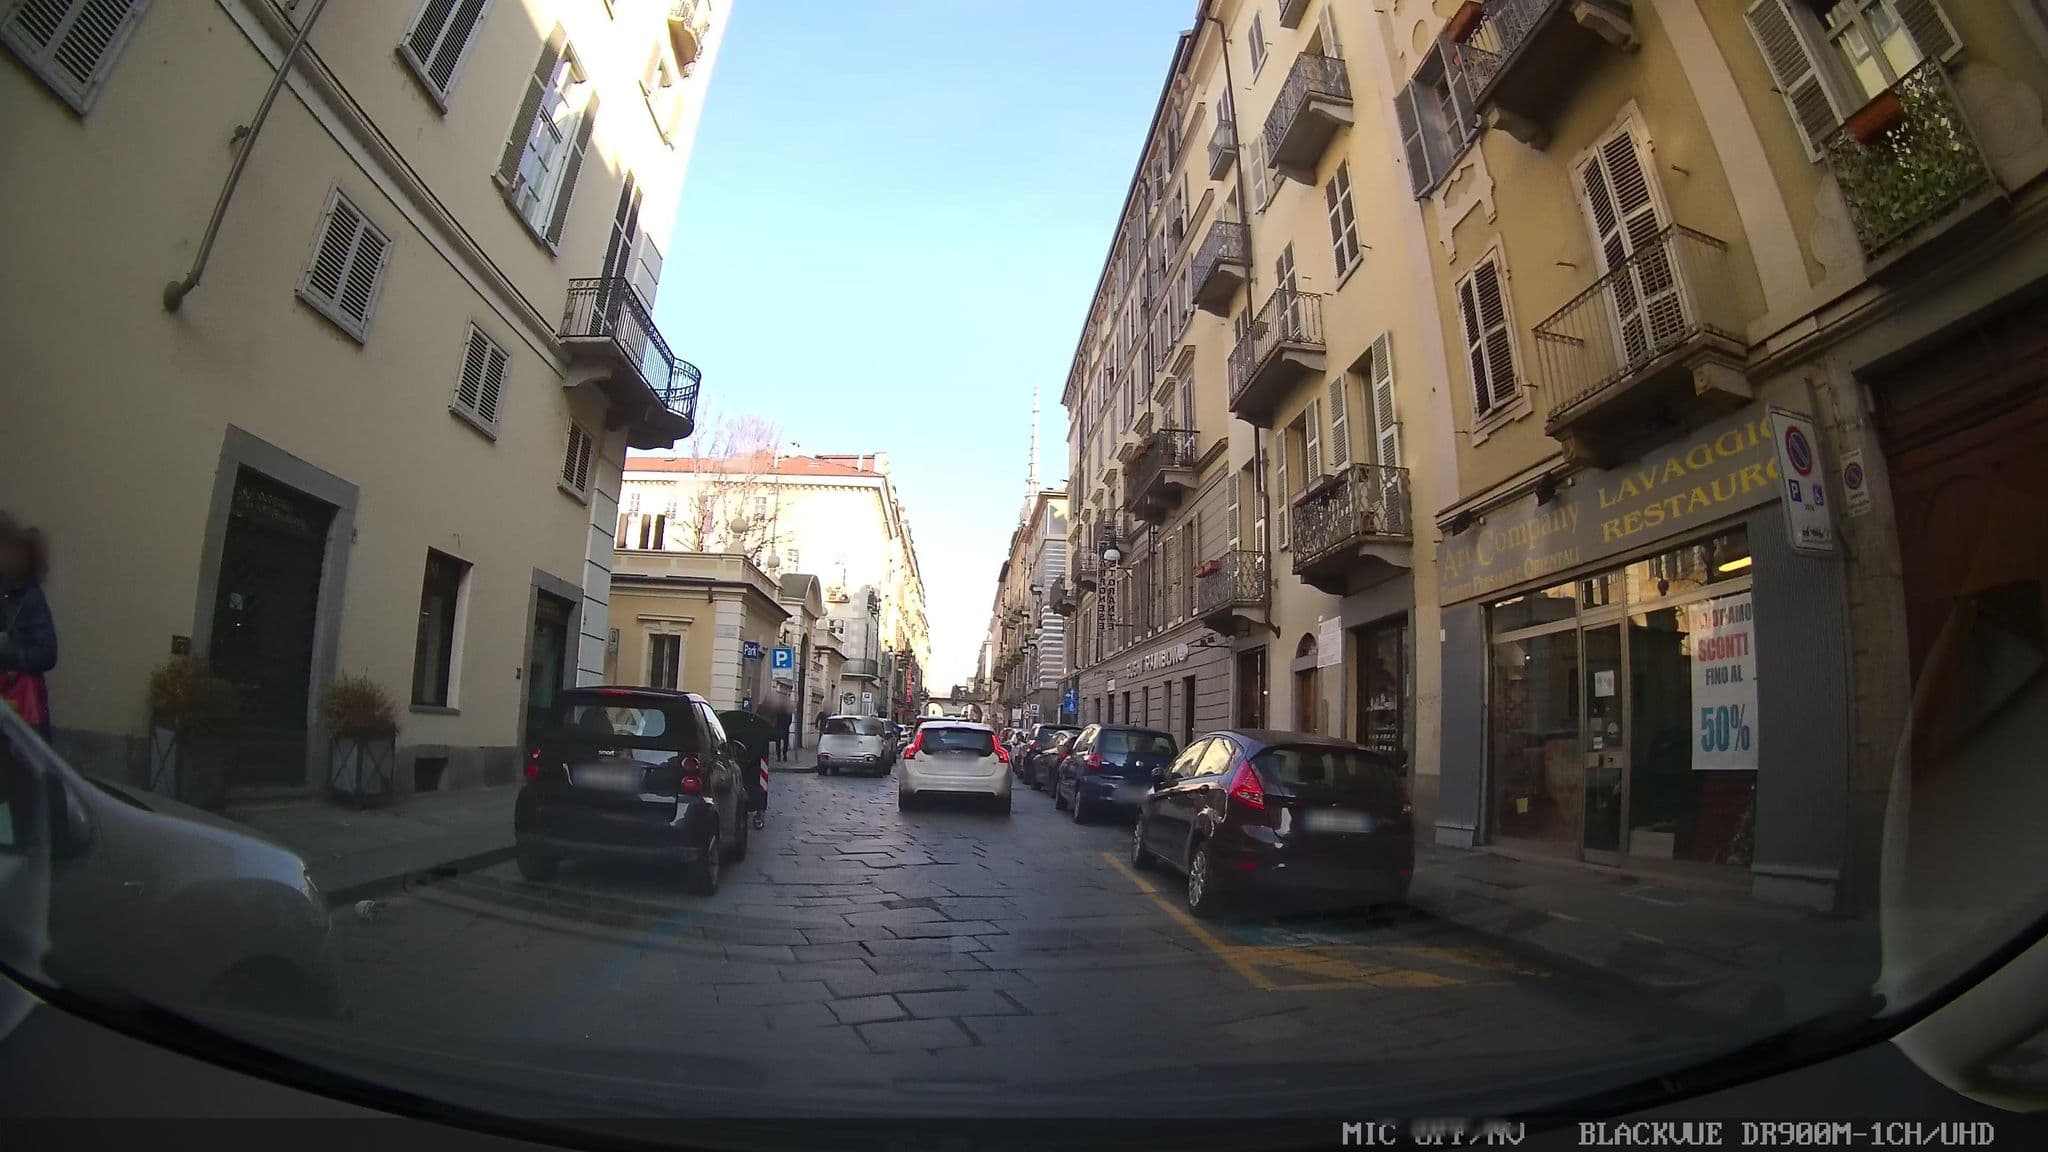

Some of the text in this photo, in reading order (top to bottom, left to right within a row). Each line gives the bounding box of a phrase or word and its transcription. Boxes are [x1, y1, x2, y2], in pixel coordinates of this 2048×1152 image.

[1477, 503, 1578, 566] Company
[744, 643, 757, 657] Park
[776, 651, 788, 666] P
[1698, 632, 1750, 662] SCONTI
[1705, 664, 1744, 686] FINO AL
[1701, 703, 1750, 752] 50%
